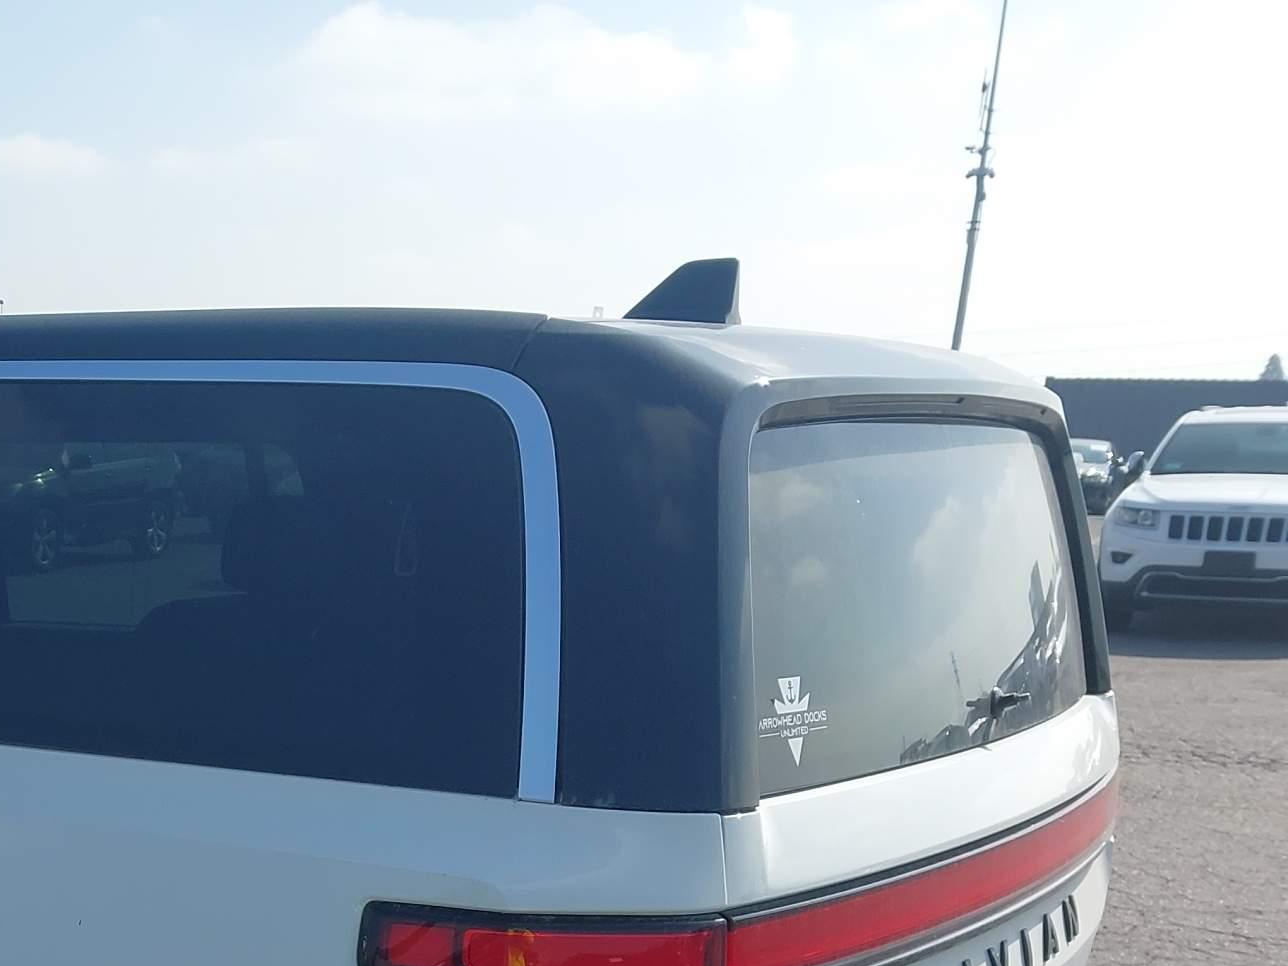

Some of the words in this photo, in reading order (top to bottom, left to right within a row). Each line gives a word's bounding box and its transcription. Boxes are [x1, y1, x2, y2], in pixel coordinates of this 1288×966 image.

[759, 713, 802, 730] ARROWHEAD
[803, 709, 827, 724] DOCKS
[780, 725, 809, 738] UNLIMITED
